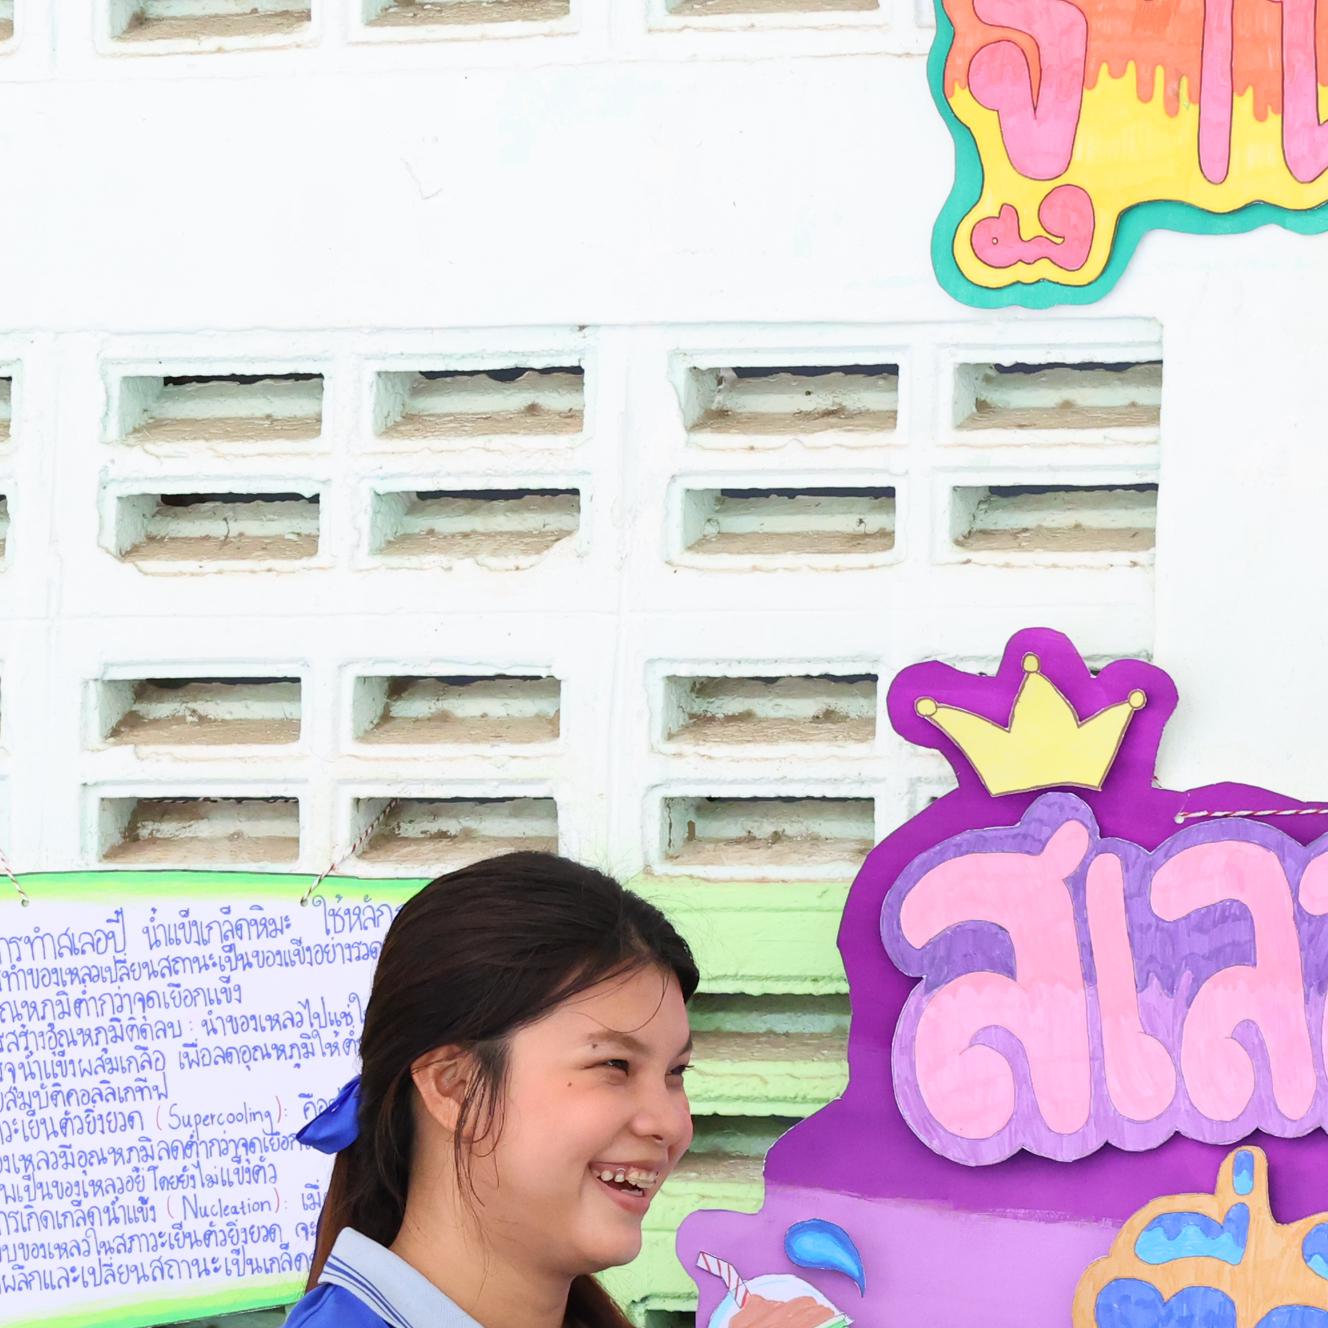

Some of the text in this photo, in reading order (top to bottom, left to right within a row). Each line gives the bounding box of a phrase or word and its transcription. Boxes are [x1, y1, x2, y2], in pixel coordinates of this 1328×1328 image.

[142, 904, 293, 951] น้ำแข็งเกล็ดหิมะ
[311, 893, 404, 936] ใช้หลัก
[201, 992, 367, 1036] นำของเหลวไปแช่ใ
[301, 1179, 328, 1211] เมื่
